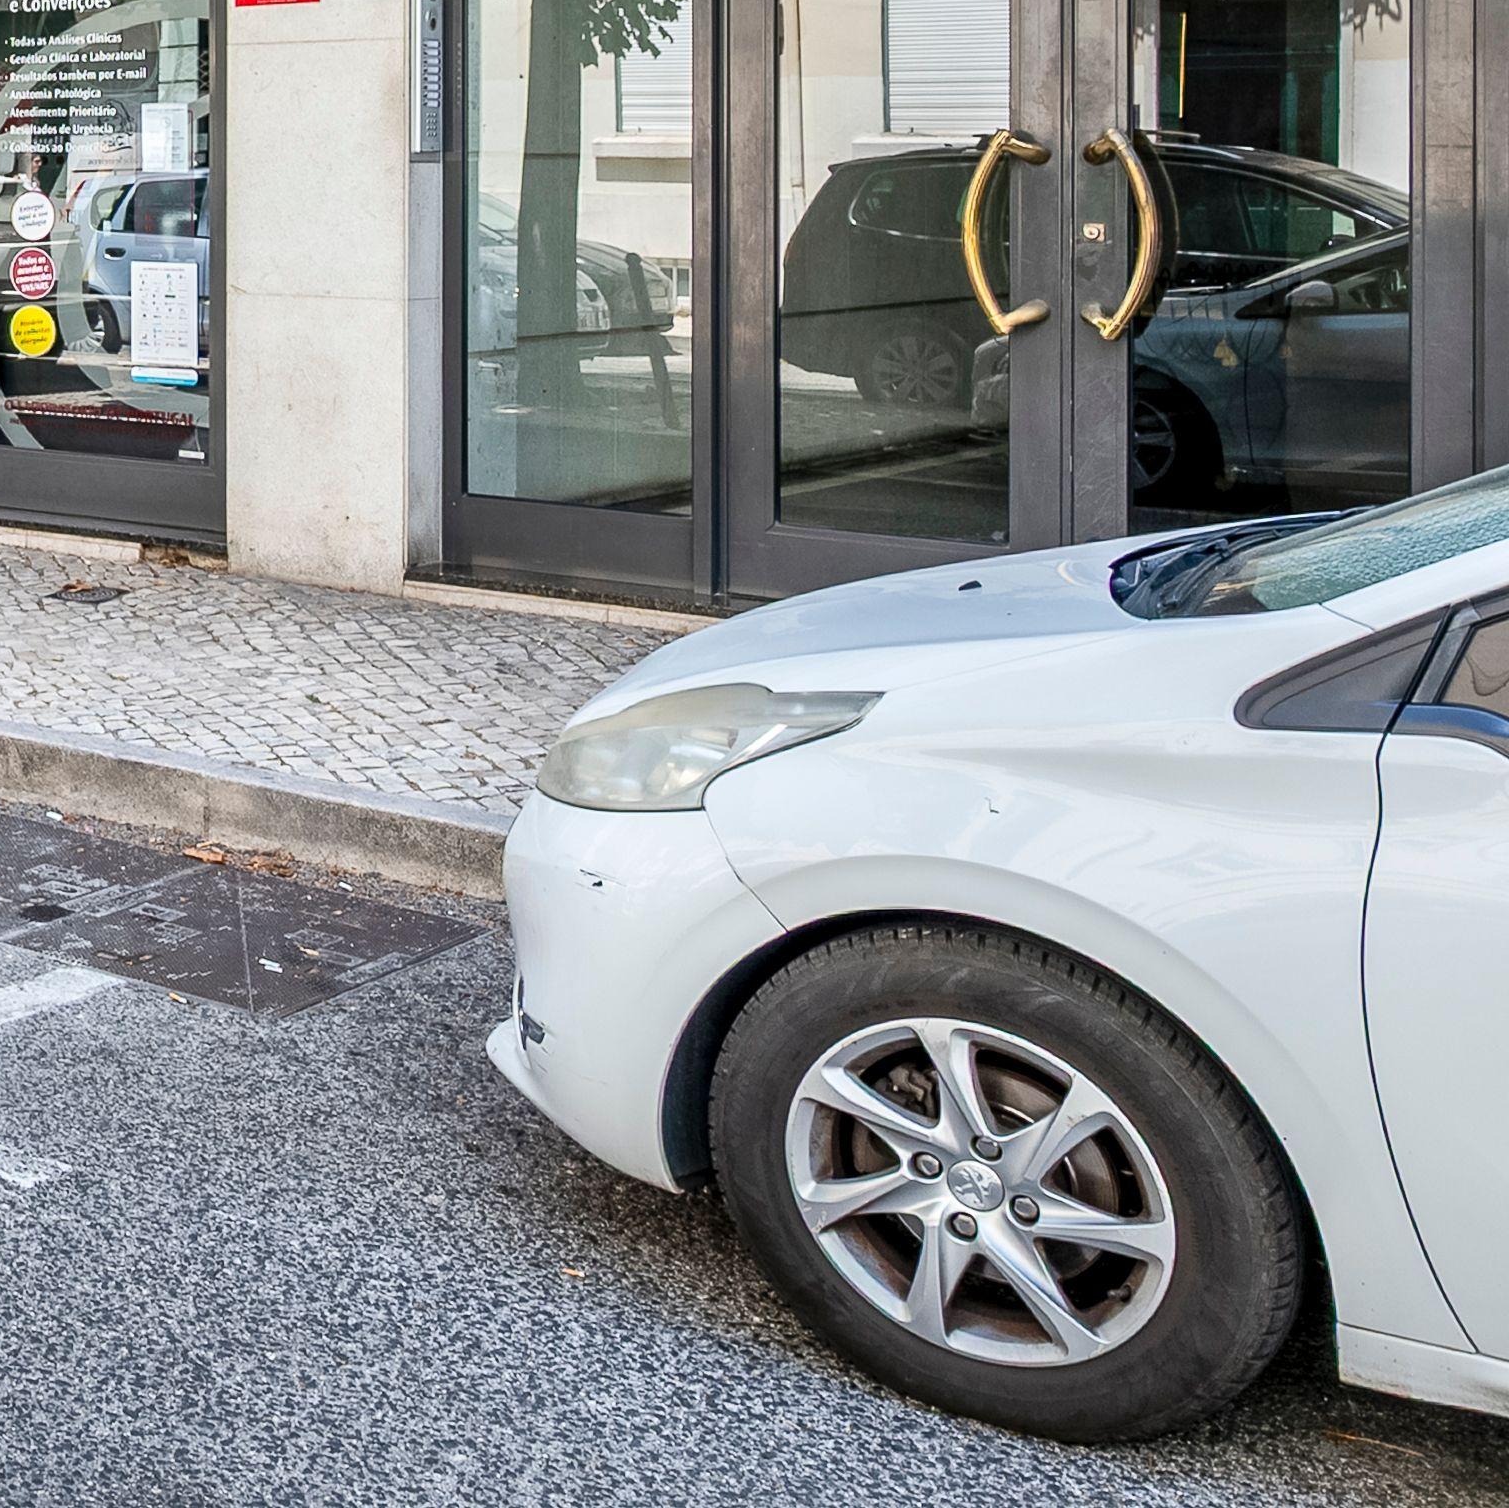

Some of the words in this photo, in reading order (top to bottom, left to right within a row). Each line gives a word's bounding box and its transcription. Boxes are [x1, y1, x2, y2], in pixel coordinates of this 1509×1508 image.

[9, 0, 19, 13] e
[9, 35, 35, 48] Todas
[36, 36, 47, 46] as
[48, 32, 85, 46] Análises
[86, 32, 123, 44] Clínicas
[9, 52, 47, 65] Genética
[48, 49, 80, 63] Clínica
[81, 53, 88, 63] e
[89, 47, 146, 63] Laboratorial
[9, 71, 57, 83] Resultados
[58, 68, 96, 81] também
[98, 69, 114, 82] por
[116, 66, 147, 80] E-mail
[9, 88, 52, 100] Anatomia
[53, 87, 102, 101] Patológica
[9, 105, 67, 118] Atendimento
[68, 103, 117, 117] Prioritário
[58, 123, 71, 134] de
[72, 122, 113, 135] Urgência
